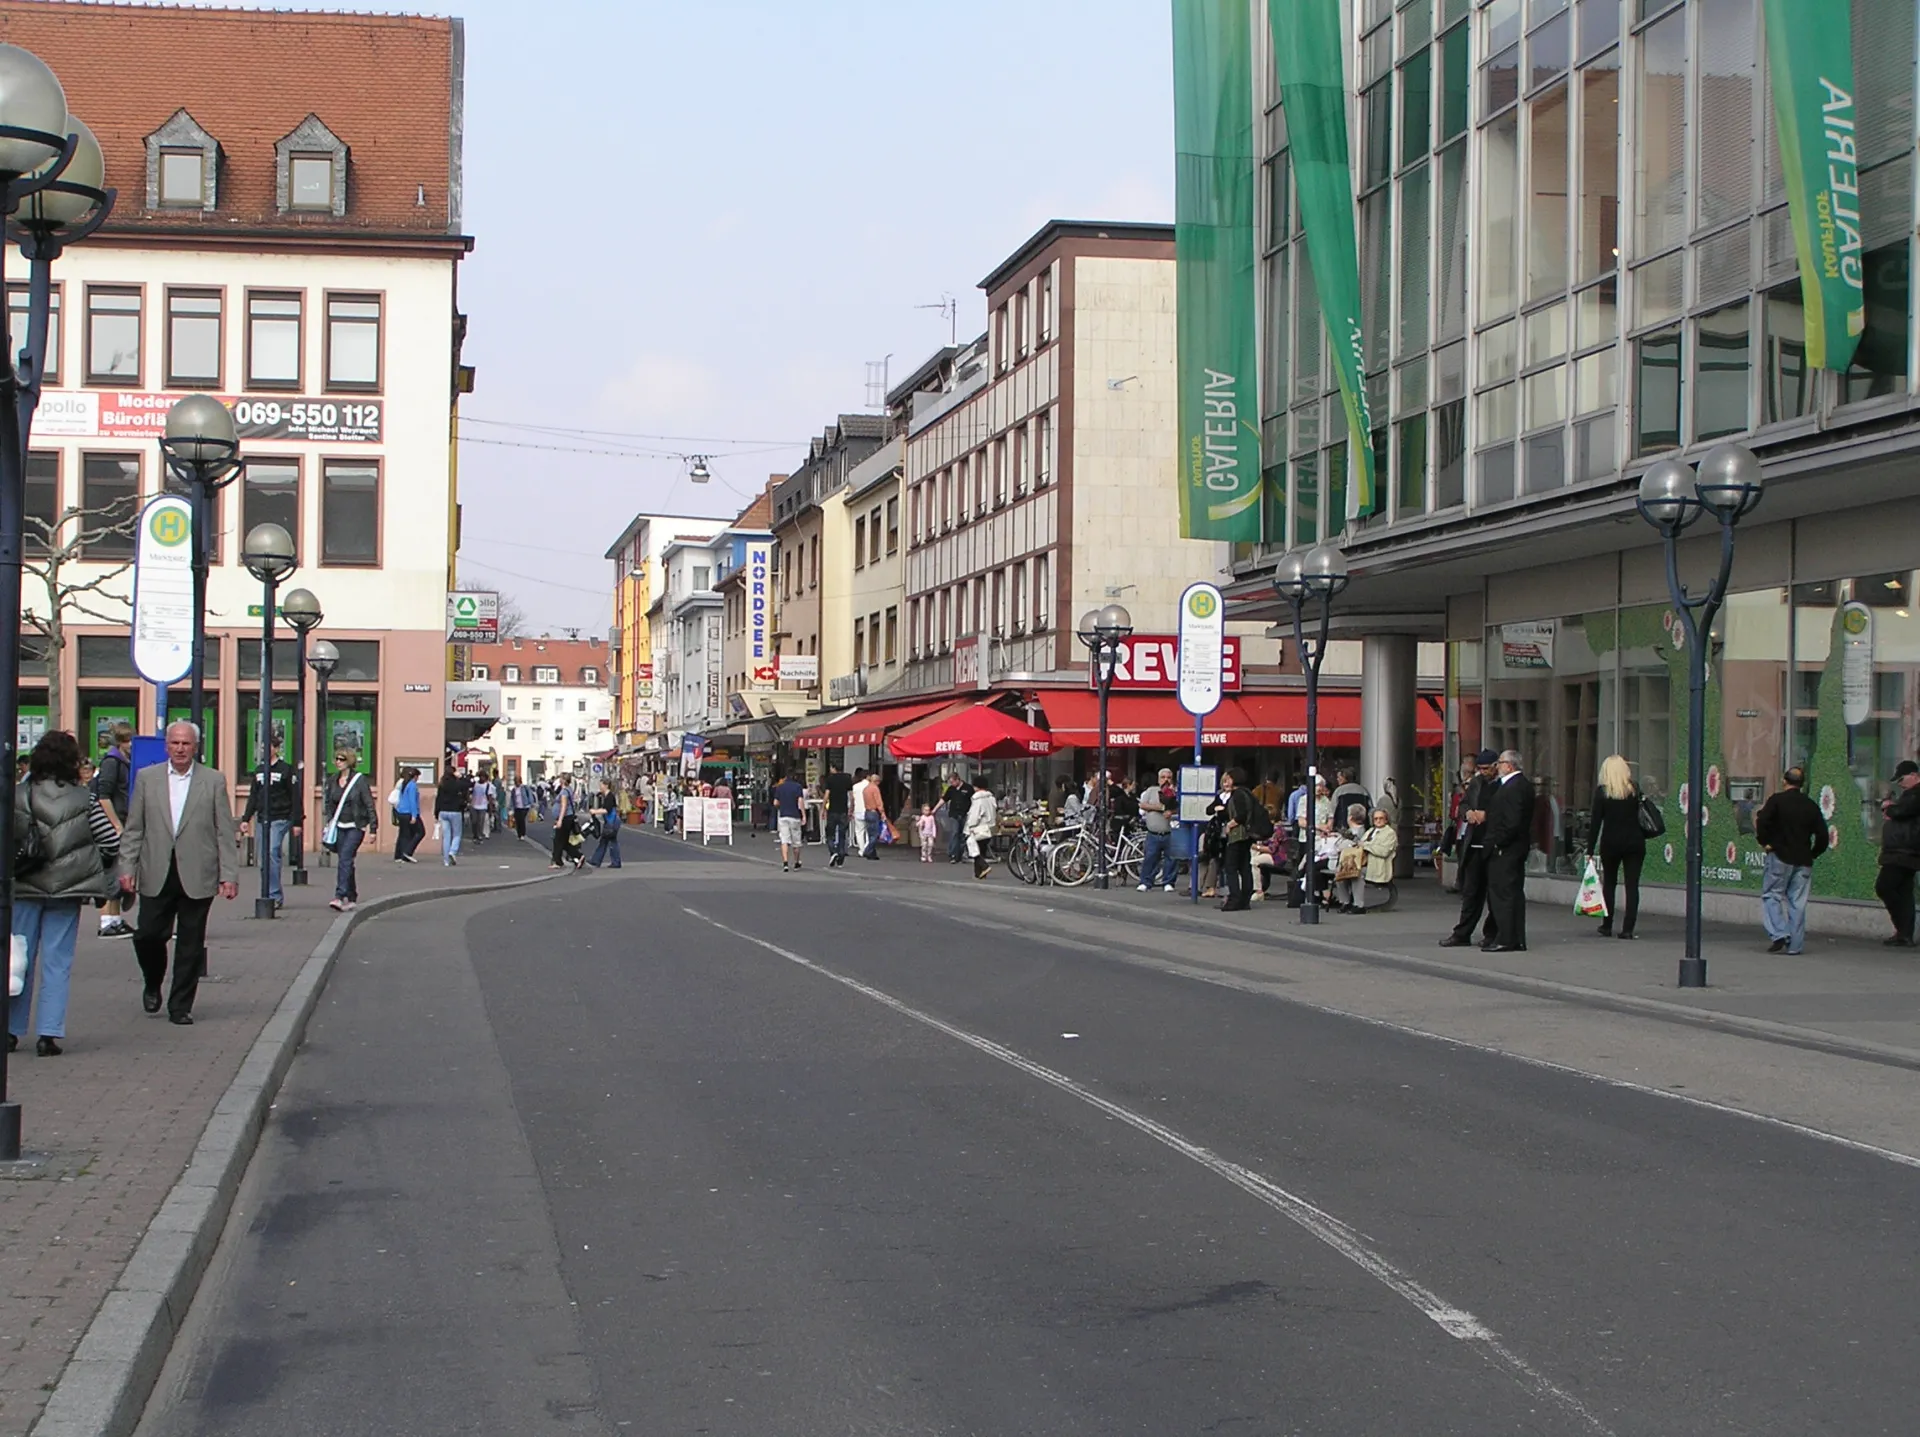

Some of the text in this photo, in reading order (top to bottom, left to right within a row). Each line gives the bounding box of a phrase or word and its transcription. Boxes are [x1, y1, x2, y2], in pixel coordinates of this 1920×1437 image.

[38, 400, 87, 417] pollo
[235, 402, 379, 427] 069-550 112
[160, 515, 179, 537] H
[752, 550, 766, 658] NORDSEE
[451, 700, 490, 715] family
[935, 740, 962, 752] REWE
[1029, 740, 1050, 752] REWE
[1109, 734, 1140, 743] REWE
[1717, 867, 1743, 881] OSTERN
